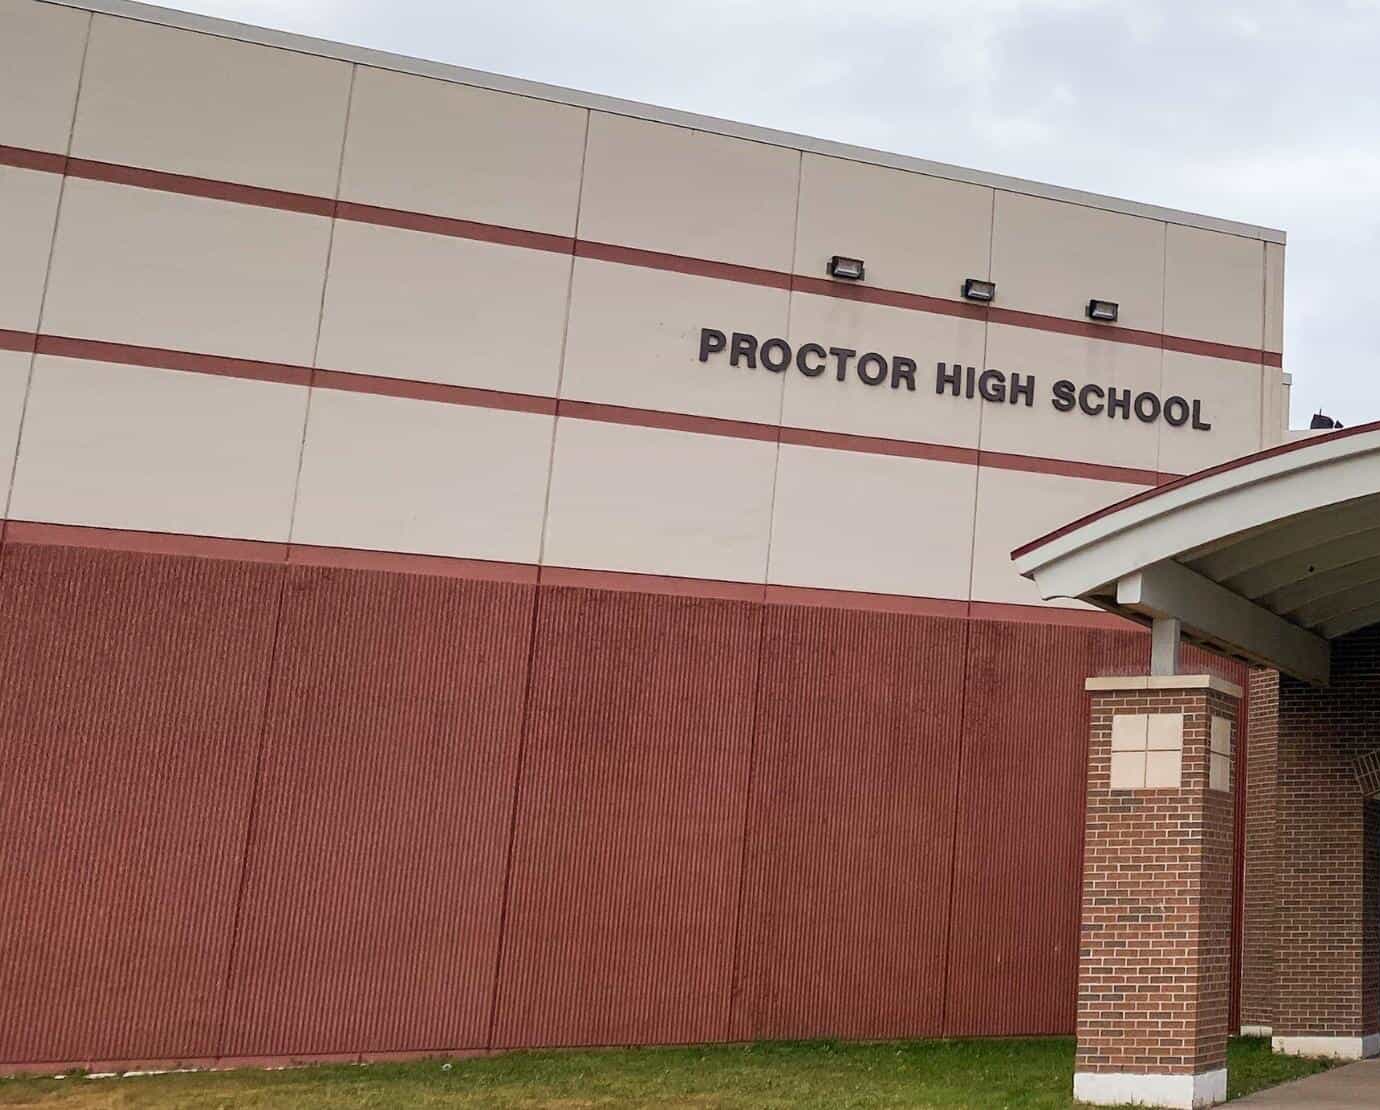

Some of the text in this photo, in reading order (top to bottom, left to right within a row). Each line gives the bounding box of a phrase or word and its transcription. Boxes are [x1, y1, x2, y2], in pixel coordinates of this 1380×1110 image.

[698, 328, 1212, 431] PROCTOR HIGH SCHOOL
